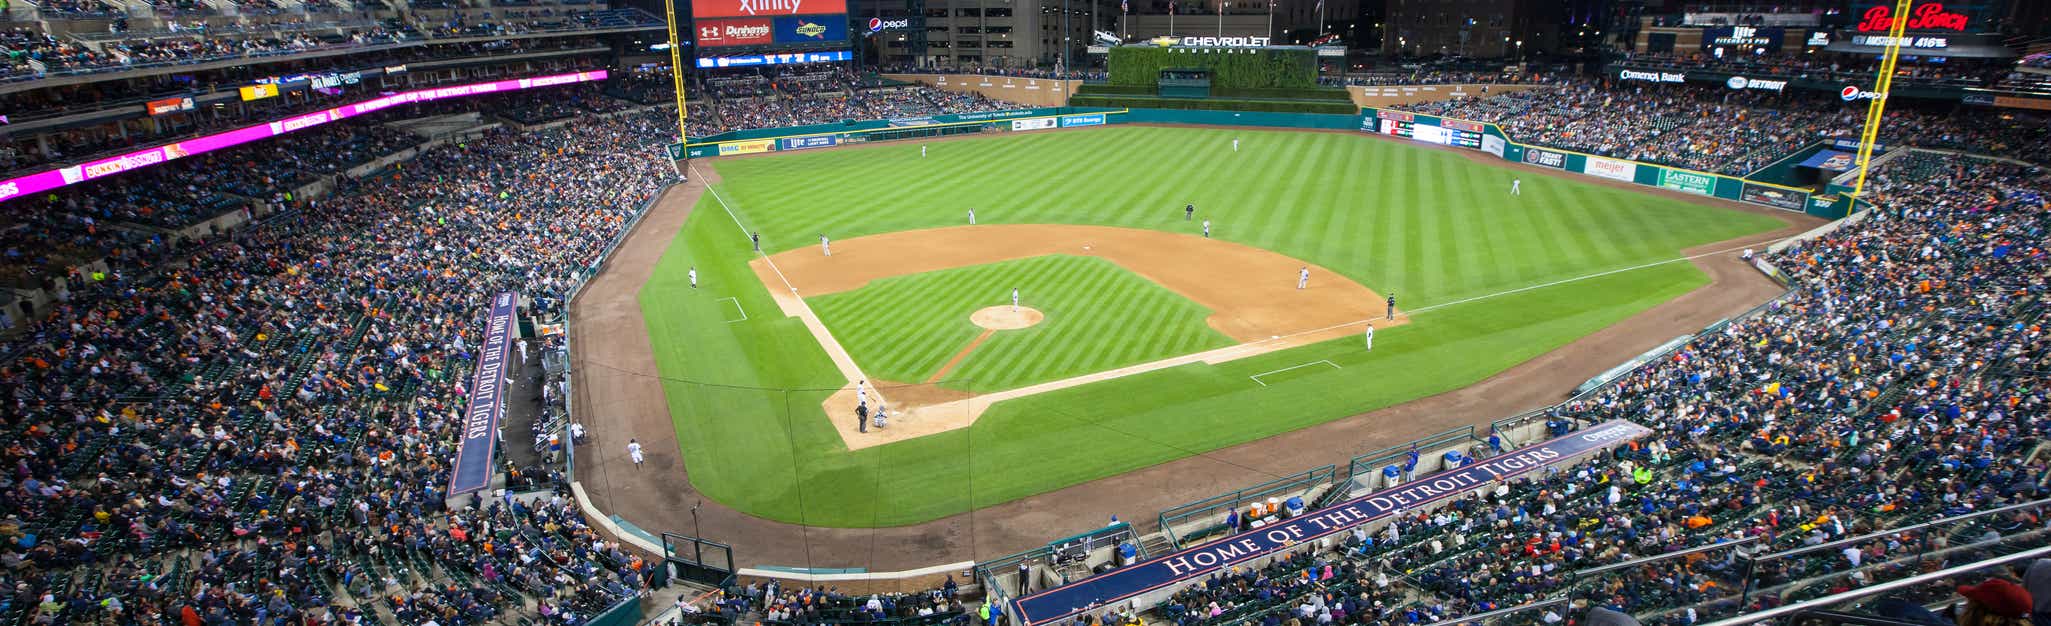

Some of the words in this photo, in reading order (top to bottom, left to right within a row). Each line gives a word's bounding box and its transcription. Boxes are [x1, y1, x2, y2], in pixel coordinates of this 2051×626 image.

[883, 19, 907, 29] pepsi
[797, 26, 825, 34] SUNOCO
[1184, 36, 1270, 46] CHEVROLET
[1914, 37, 1936, 47] 416
[1661, 72, 1685, 82] Bank
[1748, 79, 1787, 91] DETROIT
[1857, 91, 1888, 100] pep
[1540, 157, 1561, 166] FAST!
[1595, 160, 1624, 173] meijer
[1665, 169, 1709, 185] EASTERN
[490, 315, 510, 335] HOME
[488, 335, 503, 344] OF
[485, 345, 501, 361] THE
[476, 362, 500, 400] DETROIT
[468, 401, 493, 439] TIGERS
[1163, 538, 1261, 577] HOME
[1267, 524, 1304, 544] OF
[1308, 507, 1369, 530] THE
[1366, 471, 1479, 512] DETROIT
[1475, 447, 1560, 478] TIGERS
